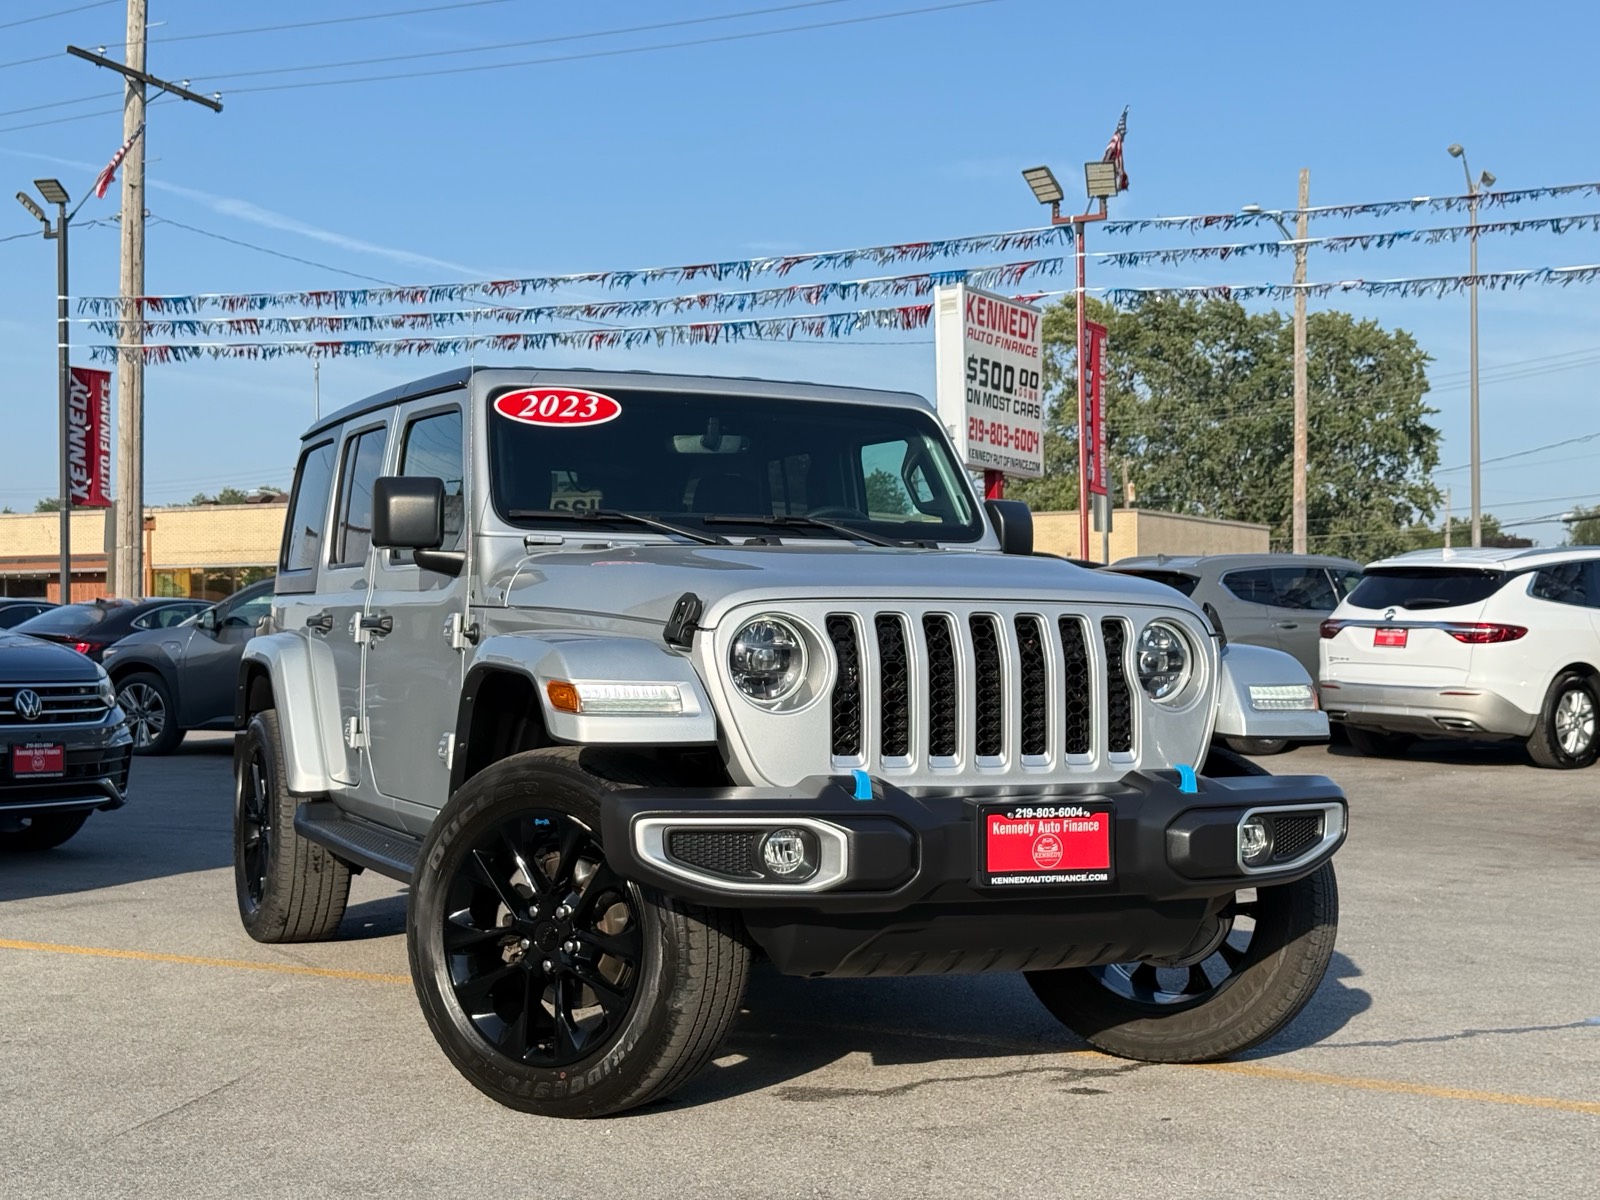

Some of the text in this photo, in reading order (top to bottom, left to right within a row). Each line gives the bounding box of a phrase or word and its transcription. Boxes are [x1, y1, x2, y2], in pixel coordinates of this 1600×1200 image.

[966, 293, 1038, 342] KENNEDY
[967, 329, 1038, 358] AUTO FINANCE
[517, 394, 599, 417] 2023
[967, 389, 1040, 419] ON MOST CARS
[70, 374, 89, 499] KENNEDY
[100, 379, 111, 502] AUTO FINANCE
[968, 417, 1039, 454] 219-803-6004
[992, 819, 1100, 836] Kennedy Auto Finance
[1015, 807, 1083, 819] 219-803-6004
[991, 873, 1108, 885] KENNEDYAUTOFINANCE.COM
